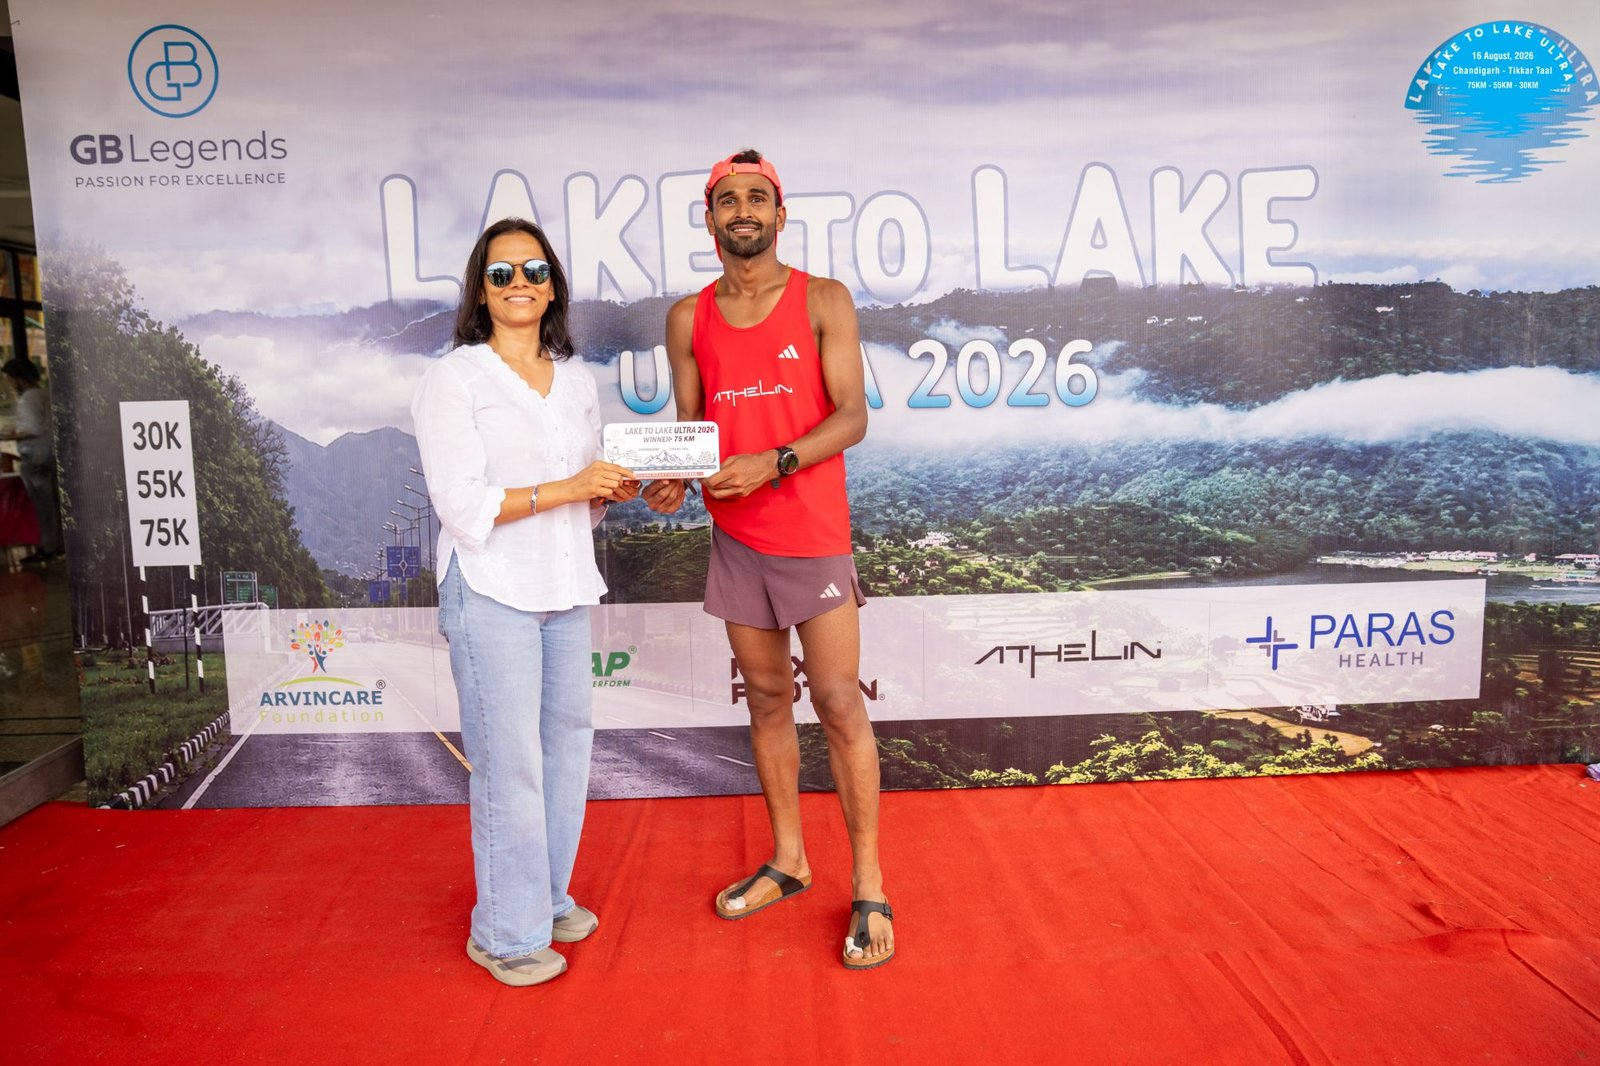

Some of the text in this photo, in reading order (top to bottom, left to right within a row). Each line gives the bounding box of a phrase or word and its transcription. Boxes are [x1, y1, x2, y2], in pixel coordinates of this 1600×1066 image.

[1432, 24, 1574, 82] LAKE TO LAKE ULTRA
[1472, 51, 1482, 60] 16
[1514, 51, 1534, 60] 2026
[1453, 66, 1500, 76] Chandigarh
[1508, 66, 1534, 75] Tikkar
[1535, 66, 1553, 75] Taal
[1467, 81, 1487, 89] 75KM
[1493, 81, 1513, 89] 55KM
[1519, 81, 1539, 89] 30KM
[75, 173, 286, 188] PASSION FOR EXCELLENCE
[971, 162, 1319, 292] LAKE
[908, 339, 1098, 408] 2026
[713, 380, 793, 407] ATHELIN
[132, 421, 182, 451] 30K
[625, 426, 715, 435] LAKE TO LAKE ULTRA 2026
[137, 470, 186, 499] 55K
[140, 518, 190, 547] 75K
[1309, 610, 1455, 649] PARAS
[974, 630, 1161, 678] ATHELIN
[1339, 651, 1424, 668] HEALTH
[592, 680, 630, 688] ERFORM
[260, 709, 384, 723] Foundation
